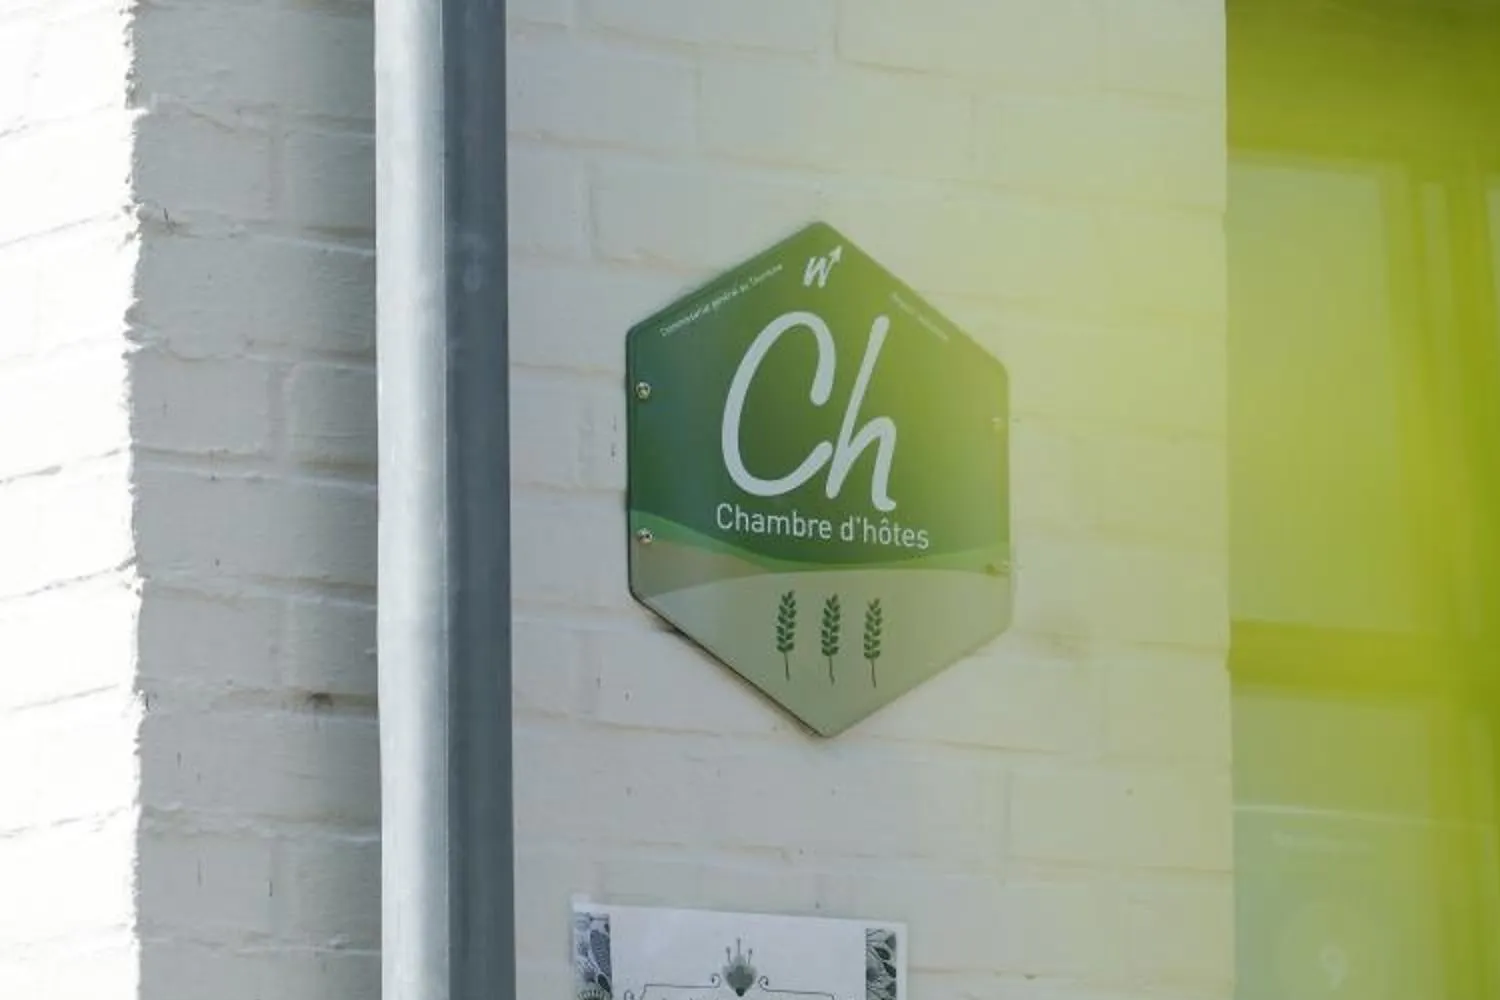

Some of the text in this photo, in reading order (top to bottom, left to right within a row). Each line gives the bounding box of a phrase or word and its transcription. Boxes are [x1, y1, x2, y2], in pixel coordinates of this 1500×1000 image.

[721, 311, 898, 512] Ch
[716, 503, 930, 549] Chambre d'hôtes
